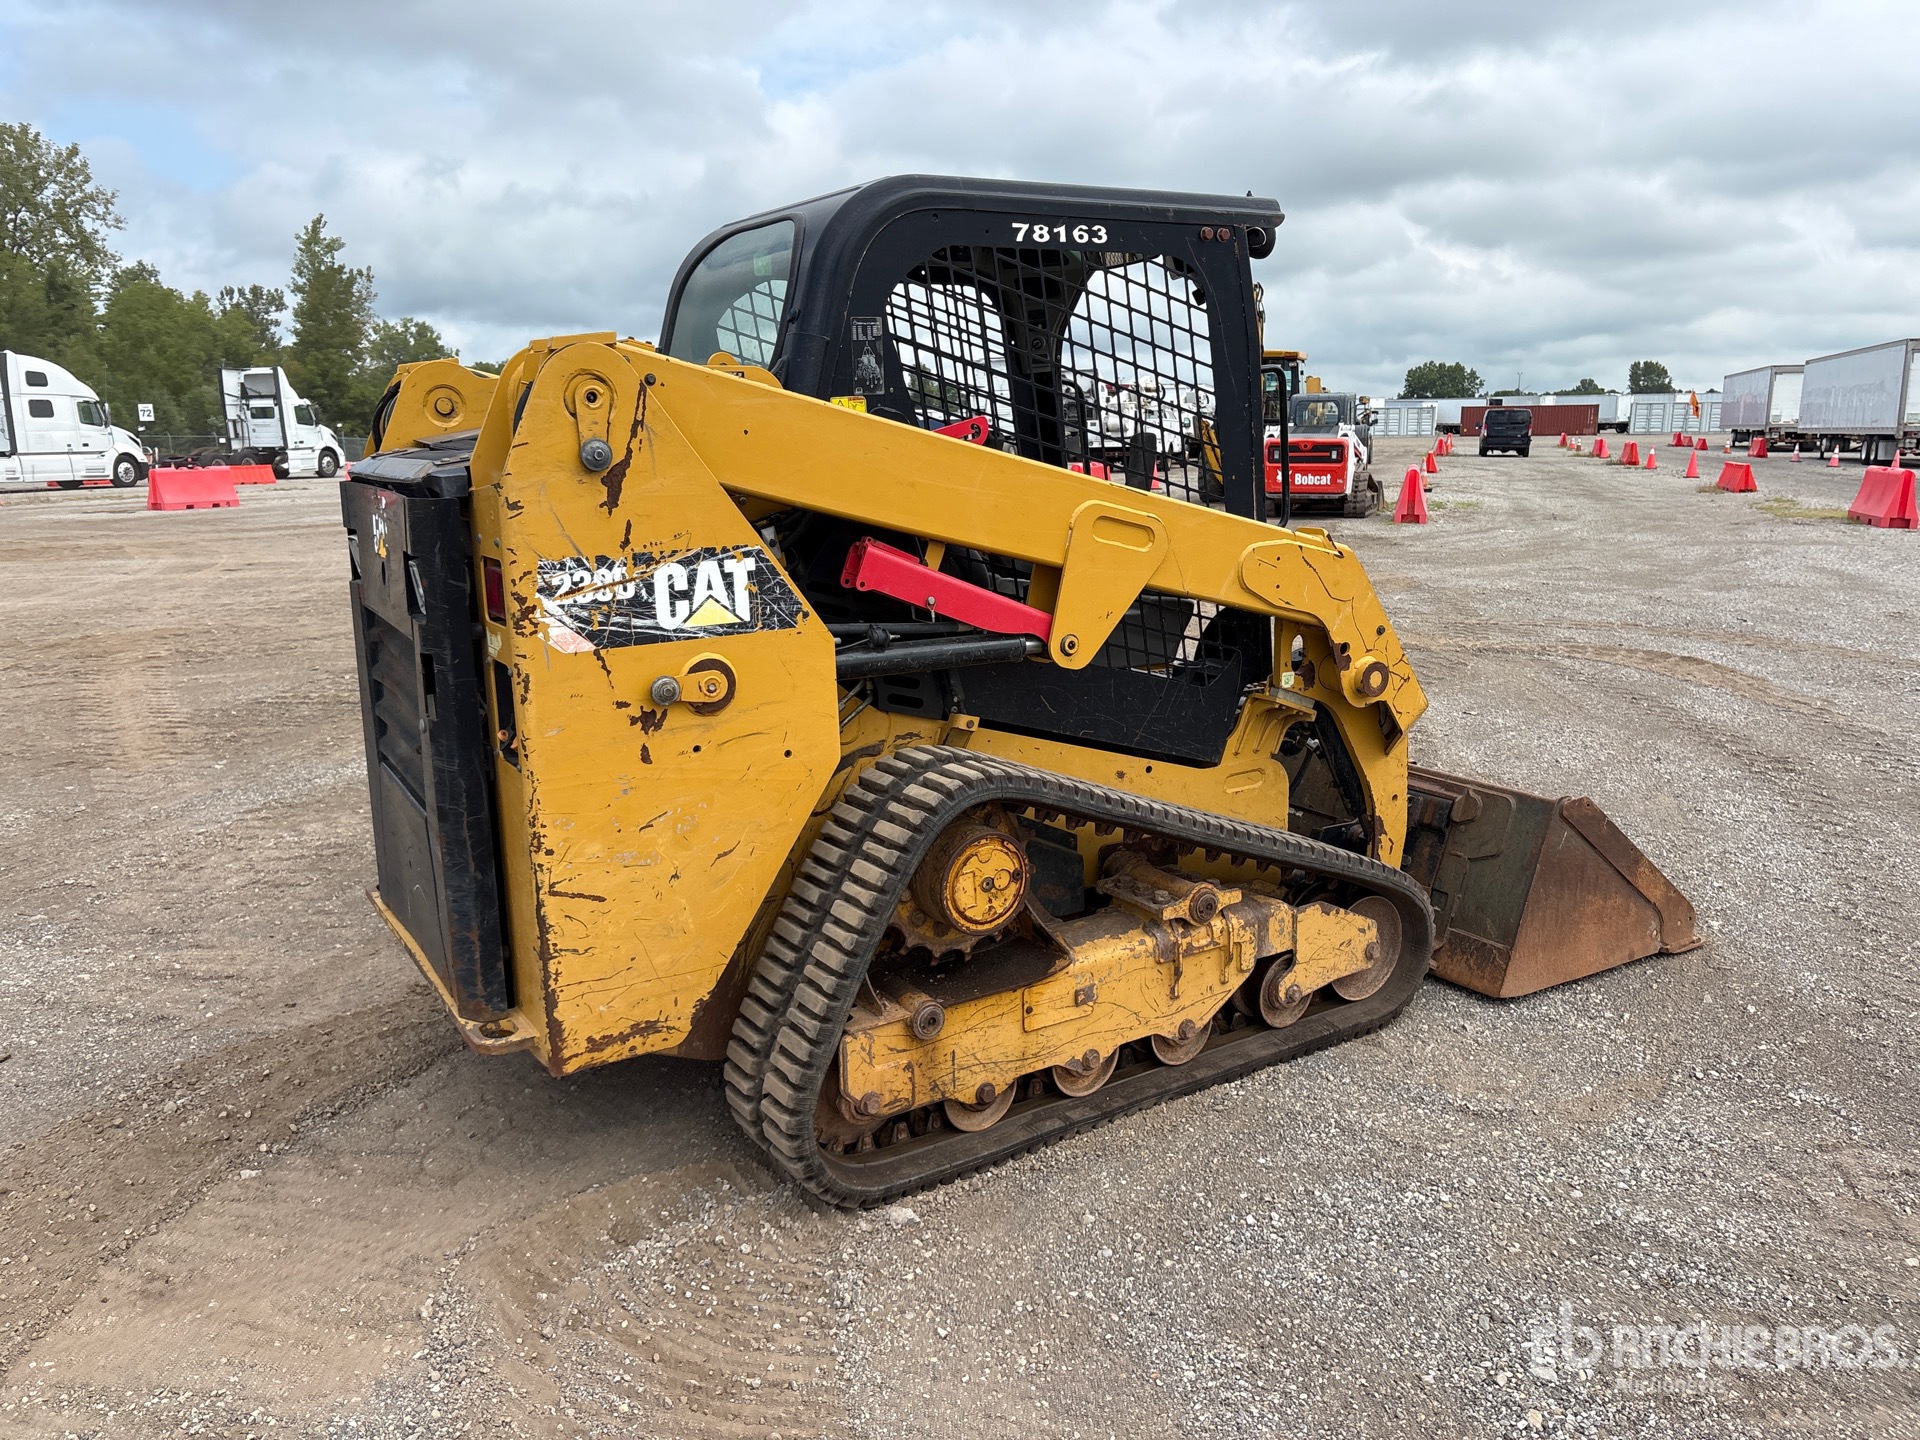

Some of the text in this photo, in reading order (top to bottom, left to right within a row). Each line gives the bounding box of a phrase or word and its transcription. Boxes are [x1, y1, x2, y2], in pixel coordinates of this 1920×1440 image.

[1011, 222, 1108, 244] 78163
[140, 409, 152, 417] 72
[1294, 473, 1331, 485] Bobcat
[654, 557, 756, 630] CAT
